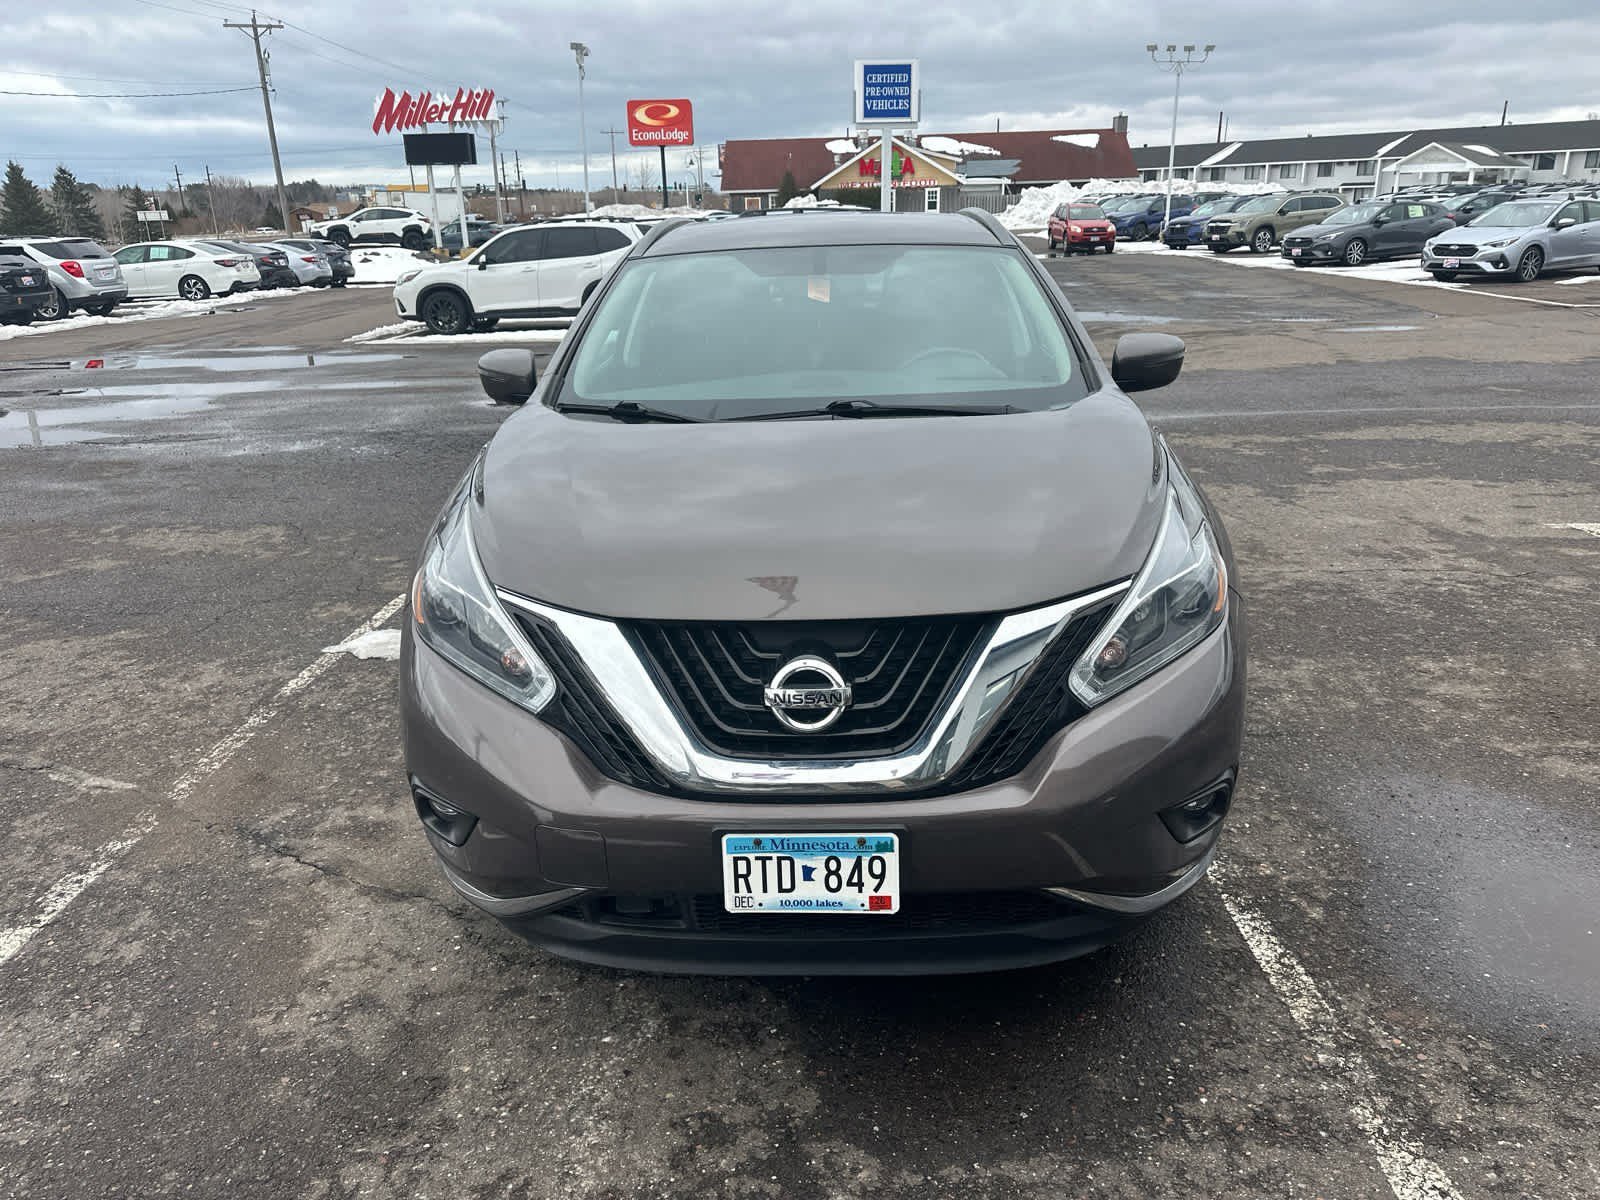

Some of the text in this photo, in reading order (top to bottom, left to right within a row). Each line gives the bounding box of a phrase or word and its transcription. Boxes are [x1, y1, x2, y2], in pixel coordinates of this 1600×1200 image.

[866, 73, 909, 83] CERTIFIED
[865, 86, 910, 97] PRE-OWNED
[865, 99, 910, 111] VEHICLES
[773, 692, 843, 705] NISSAN
[732, 855, 887, 894] RTD 849
[734, 896, 754, 908] DEC
[779, 899, 813, 909] 10,000
[815, 899, 844, 908] lakes
